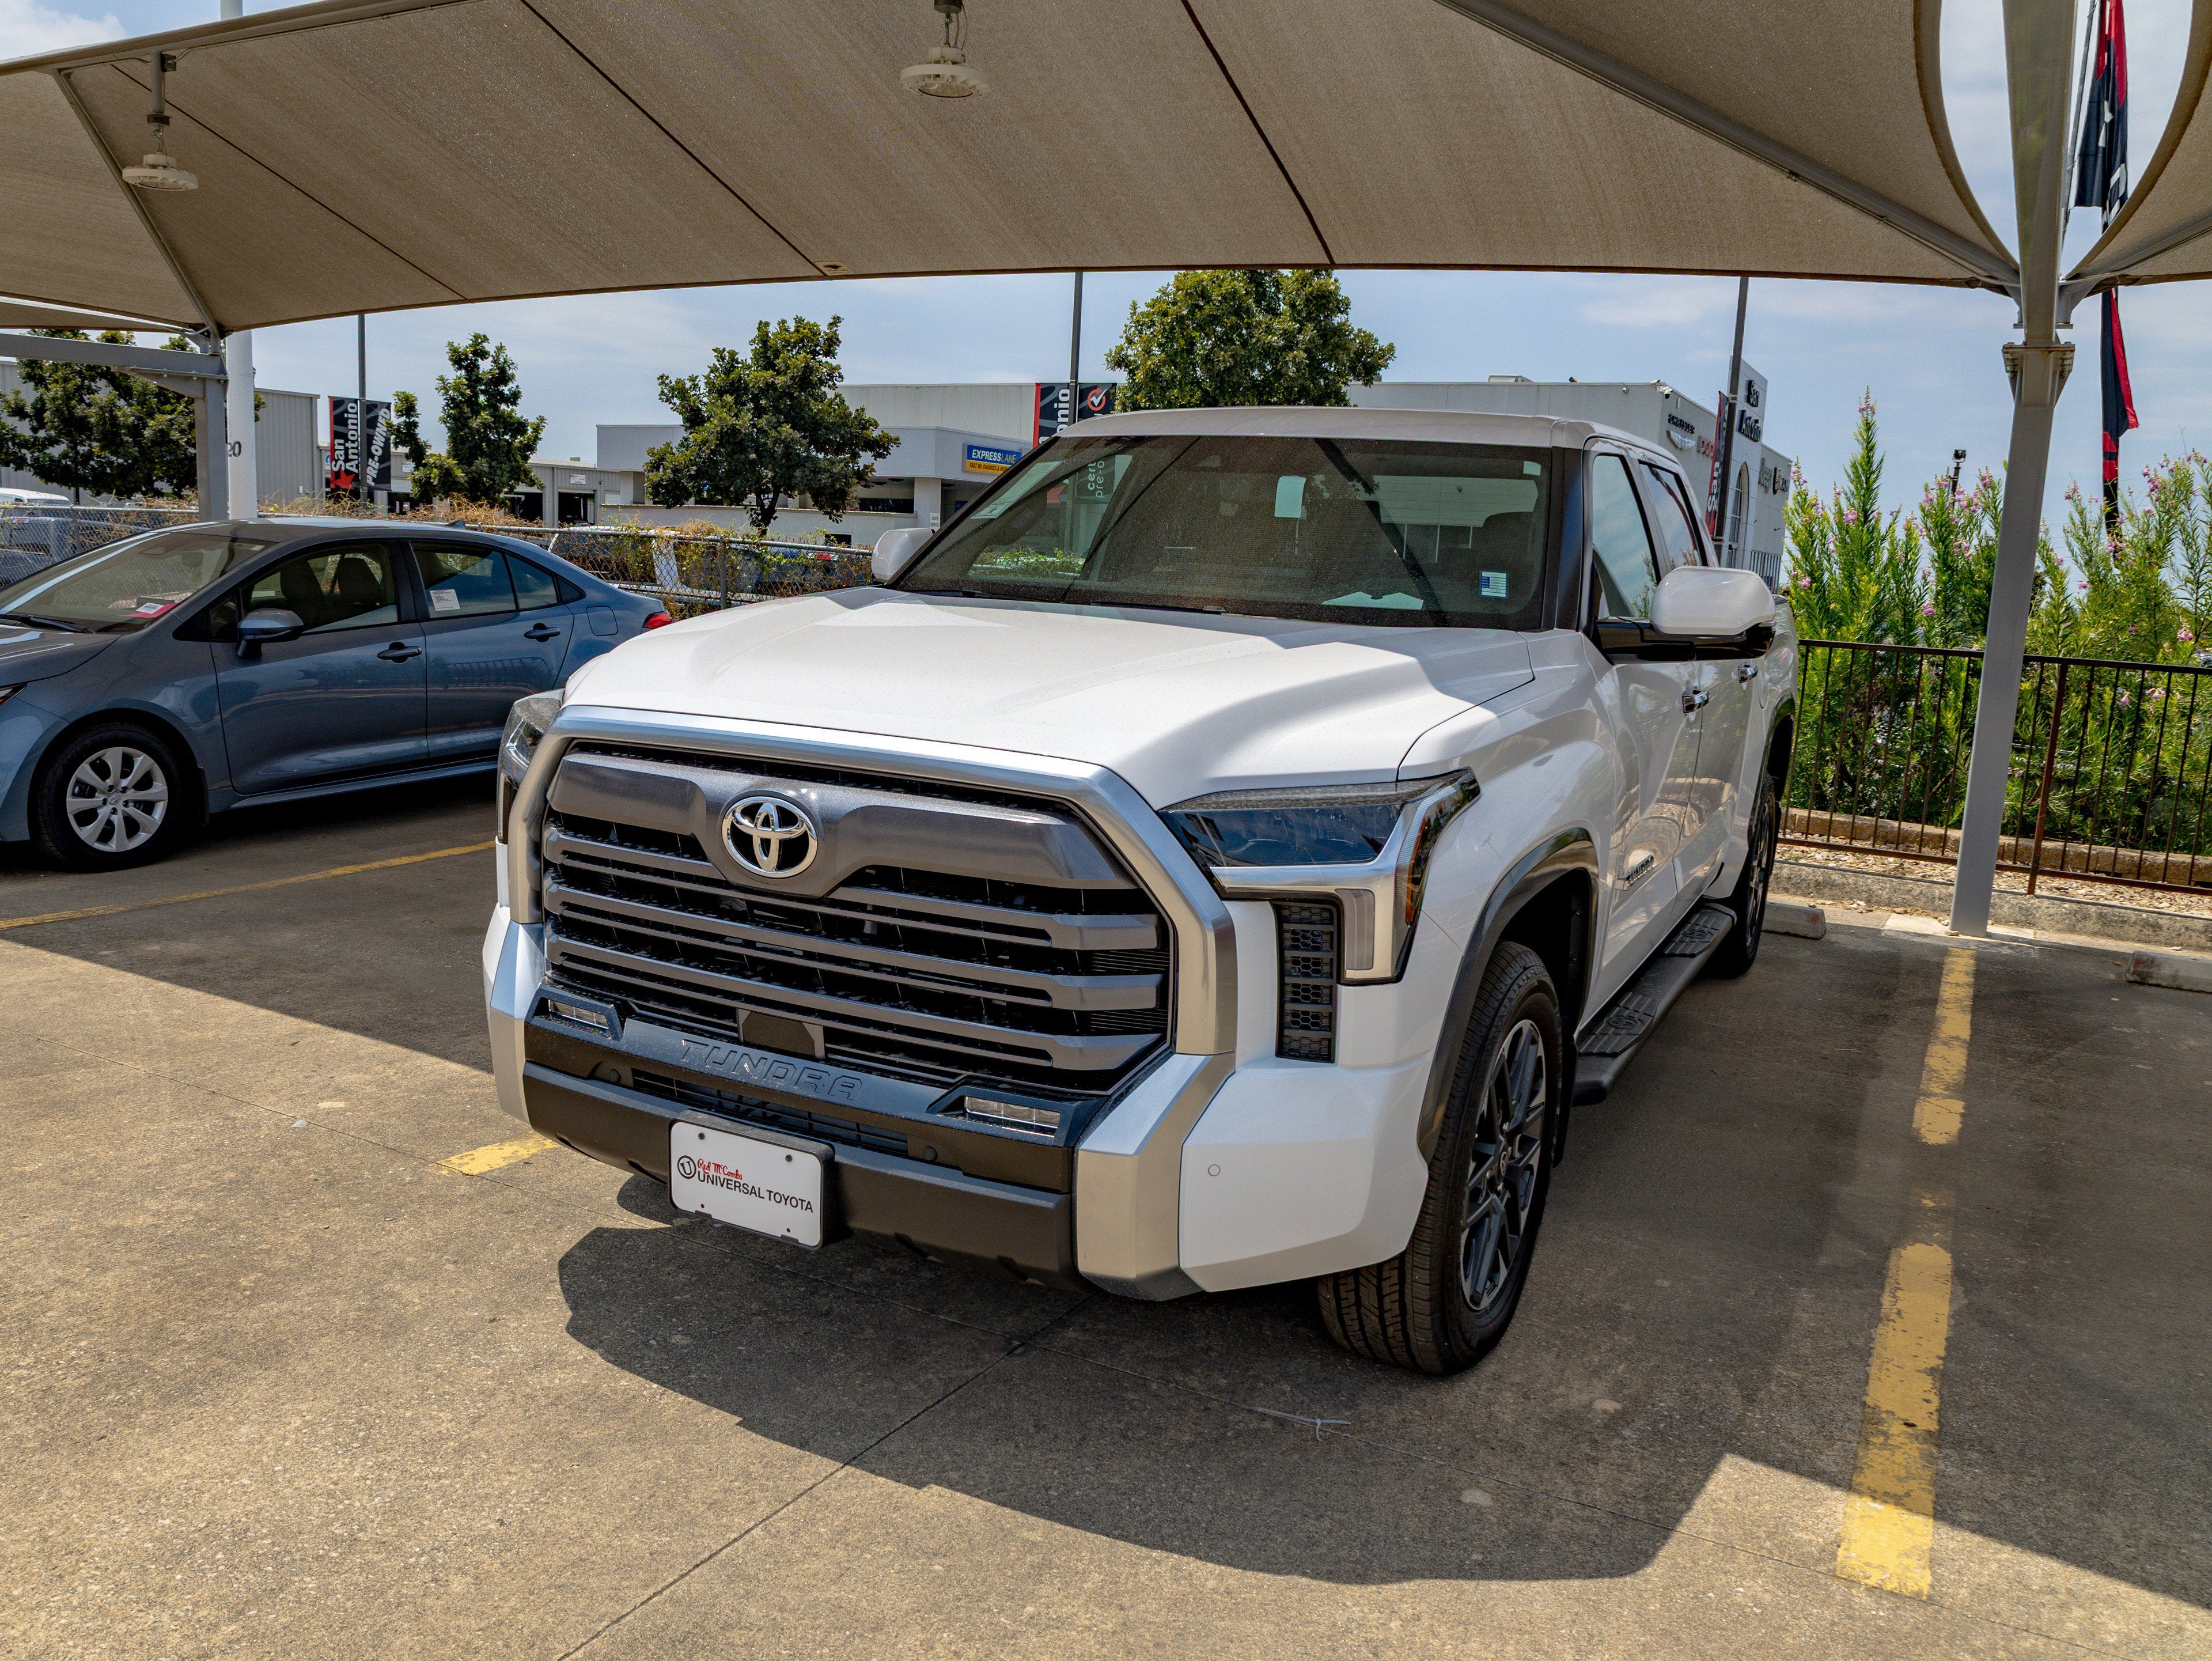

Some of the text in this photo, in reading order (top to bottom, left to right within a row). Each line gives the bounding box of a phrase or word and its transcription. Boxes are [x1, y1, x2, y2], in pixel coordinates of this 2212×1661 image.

[344, 402, 358, 474] Antonio
[1668, 414, 1695, 434] CHRYSLER
[331, 438, 344, 471] San
[366, 408, 391, 486] PRE-OWNED
[1697, 436, 1715, 458] DOD
[1096, 460, 1105, 498] pre-o
[681, 1038, 863, 1101] TUNDRA
[697, 1158, 711, 1174] Red
[698, 1170, 814, 1213] UNIVERSAL TOYOTA
